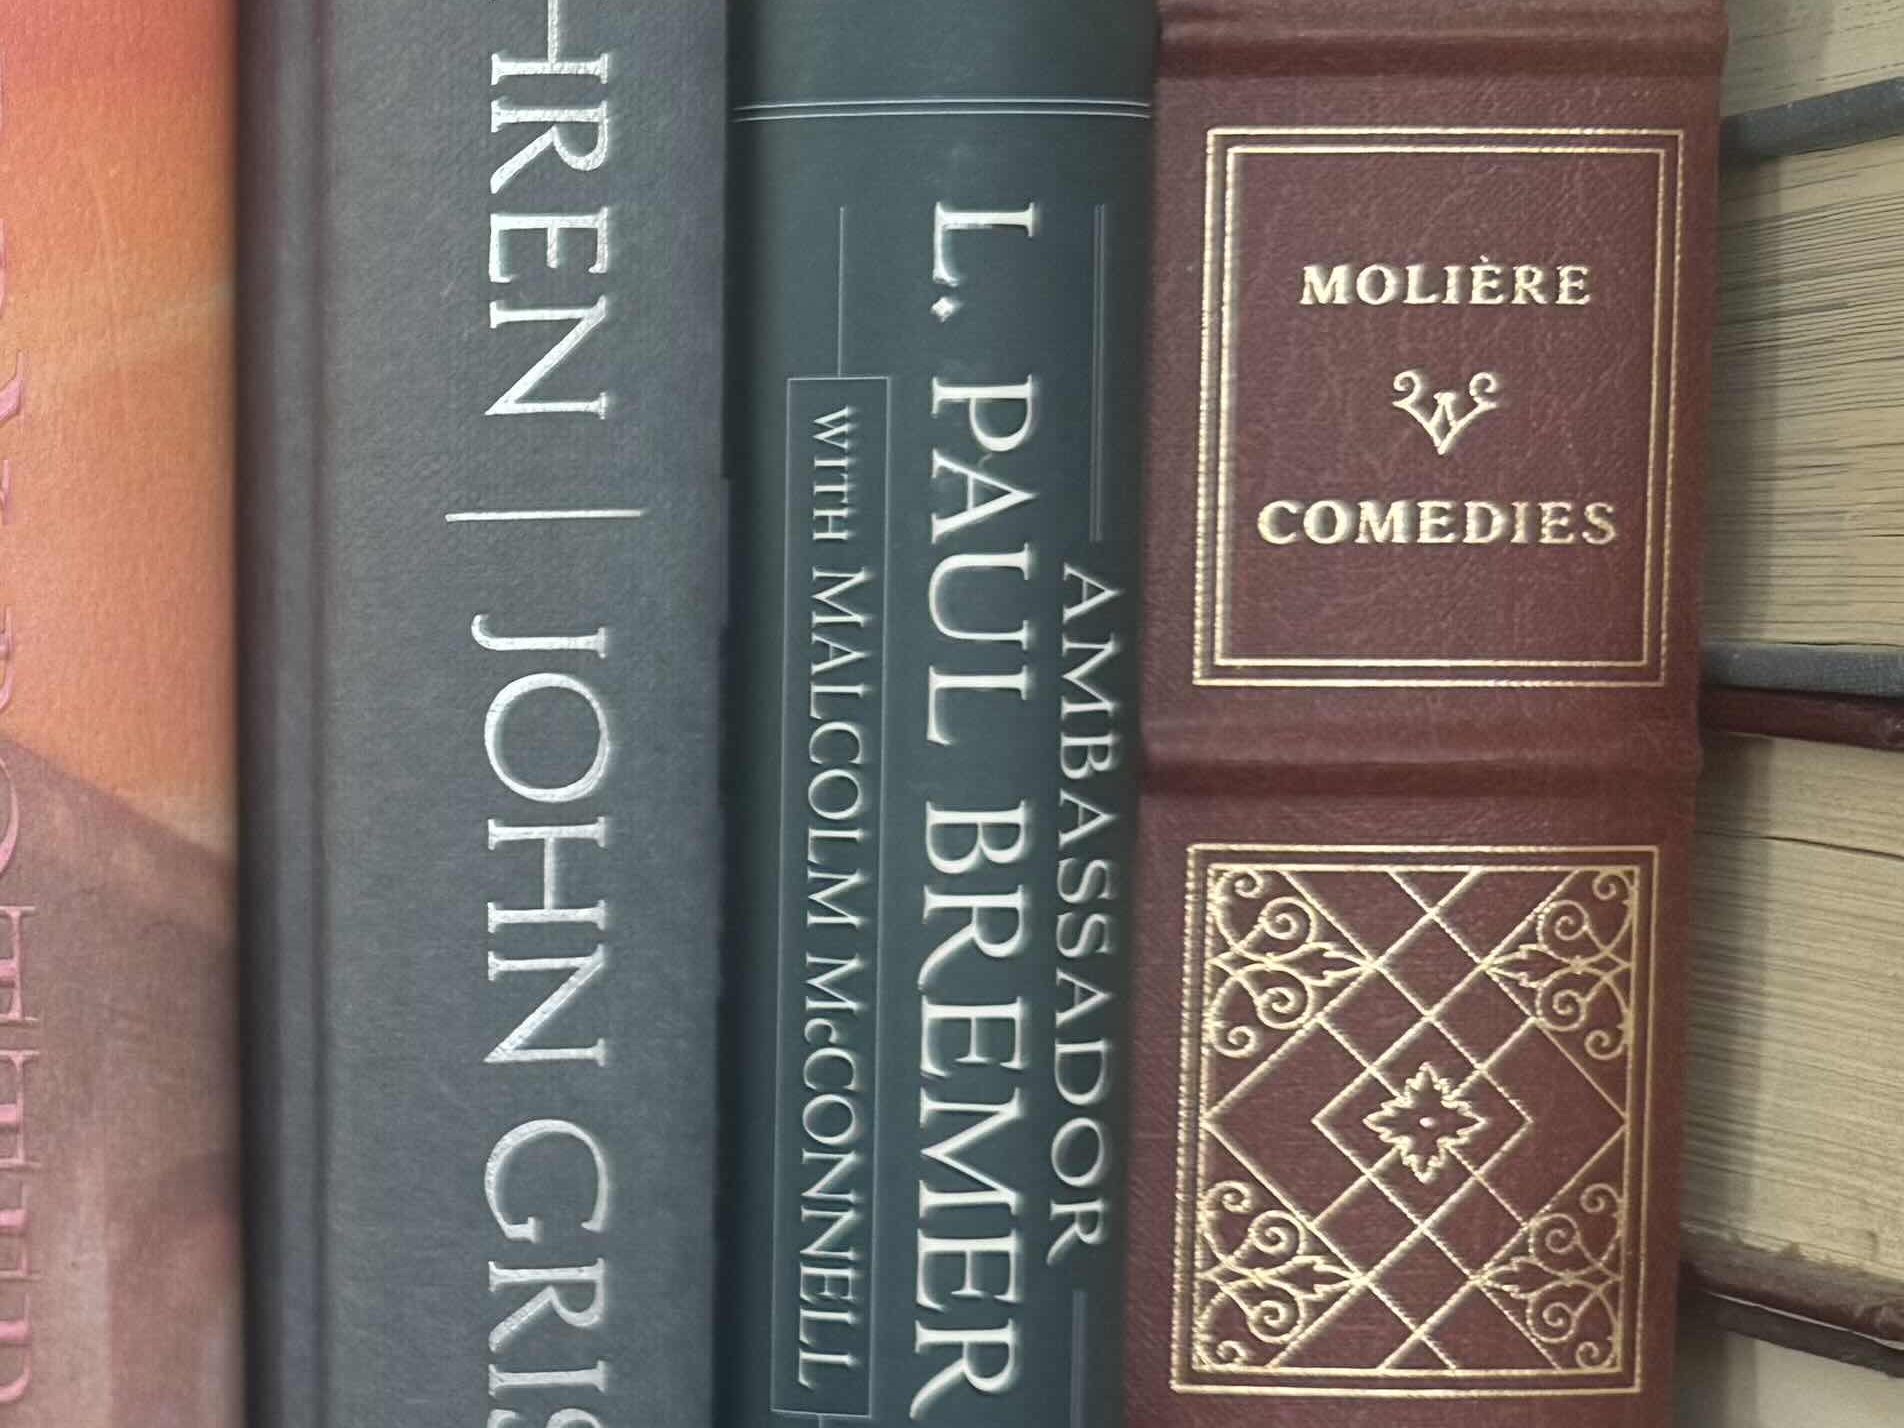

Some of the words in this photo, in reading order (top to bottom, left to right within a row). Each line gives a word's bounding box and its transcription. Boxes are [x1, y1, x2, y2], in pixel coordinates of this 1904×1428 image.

[930, 202, 1037, 322] L.
[1299, 254, 1592, 306] MOLIÈRE
[808, 404, 860, 546] WITH
[925, 375, 1035, 749] PAUL
[1257, 498, 1619, 546] COMEDIES
[472, 615, 612, 1070] JOHN
[805, 567, 869, 932] MALCOLM
[1045, 562, 1118, 1269] AMBASSADOR
[792, 950, 859, 1392] McCONNELL
[907, 800, 1032, 1422] BREMER
